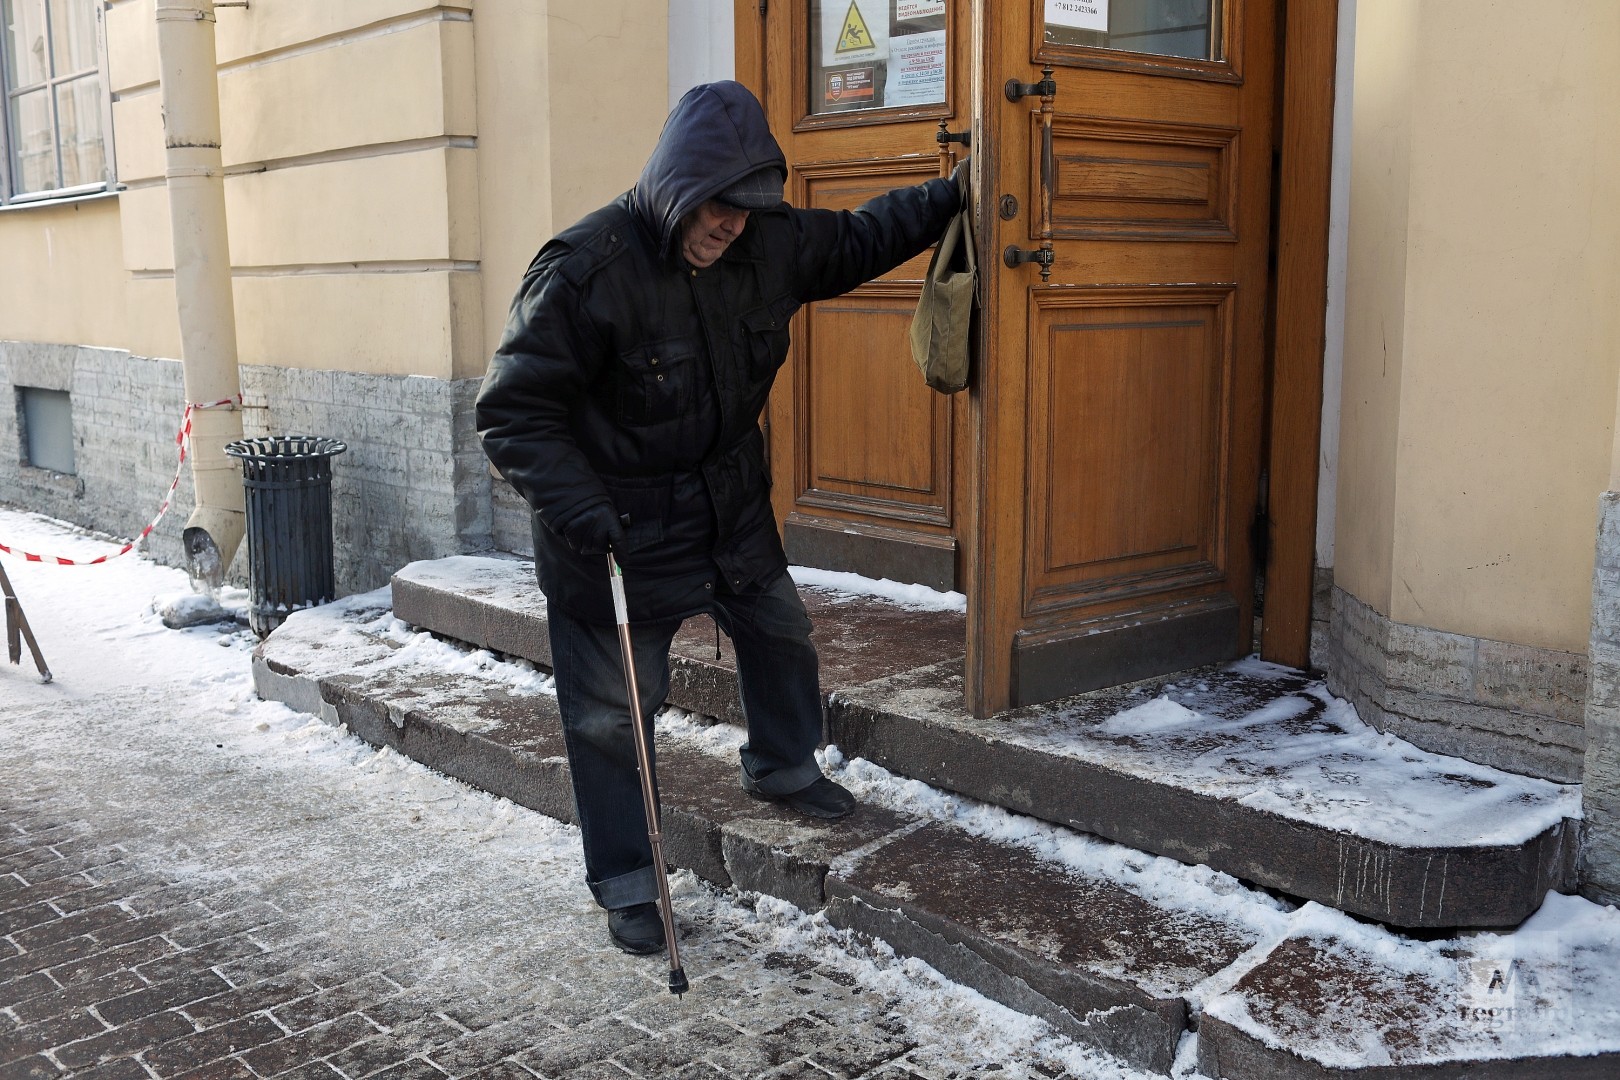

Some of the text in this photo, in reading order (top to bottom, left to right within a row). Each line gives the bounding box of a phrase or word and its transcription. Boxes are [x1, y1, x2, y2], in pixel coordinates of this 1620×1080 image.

[898, 6, 943, 18] ВИДЕОНАБЛЮДЕНИЕ
[1062, 3, 1073, 11] 812
[1074, 5, 1098, 14] 2423366
